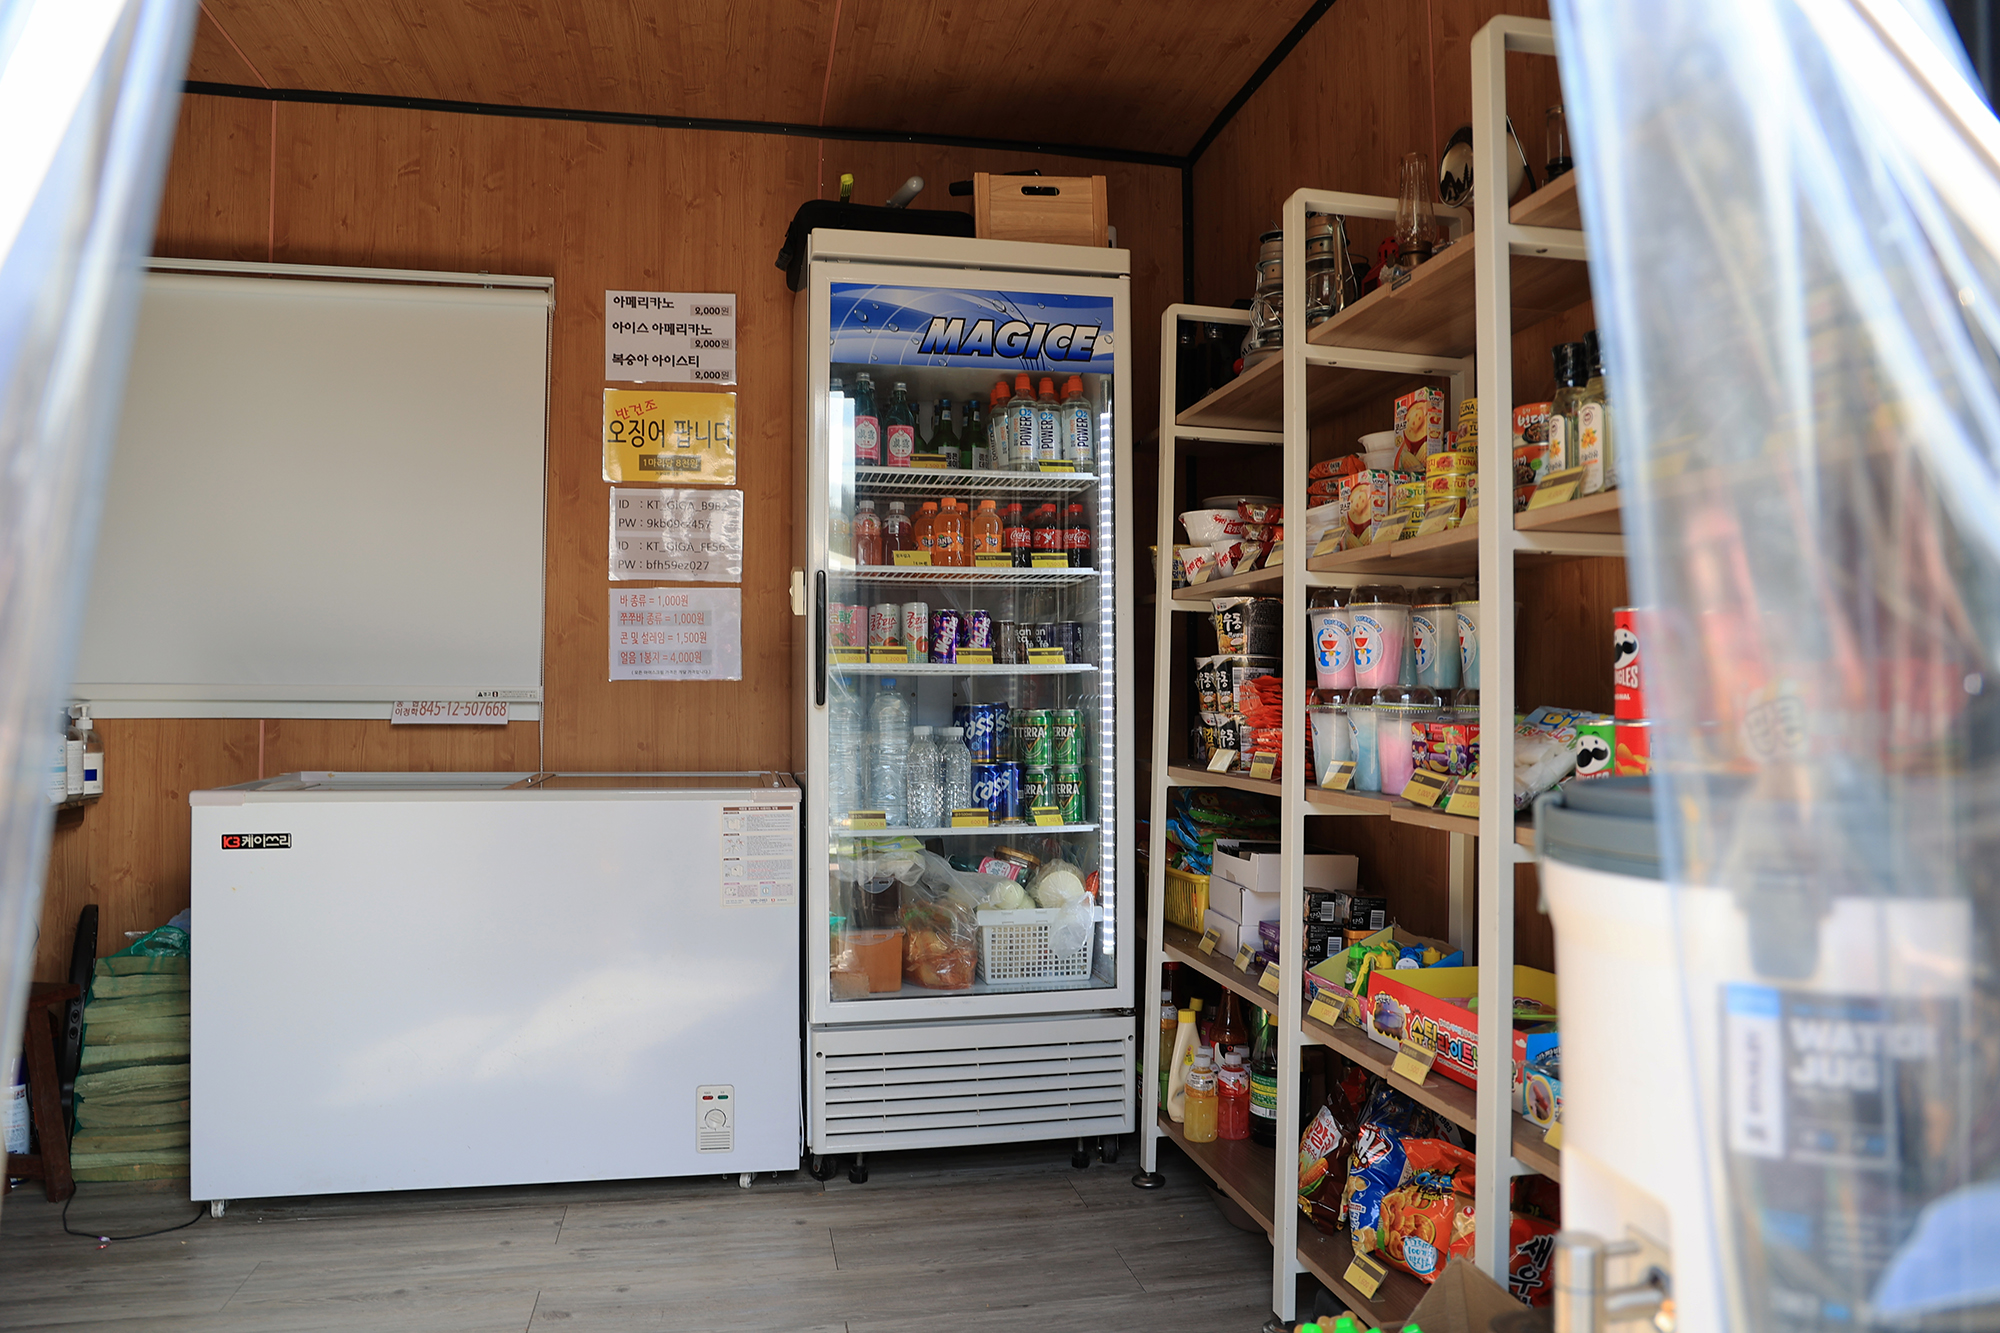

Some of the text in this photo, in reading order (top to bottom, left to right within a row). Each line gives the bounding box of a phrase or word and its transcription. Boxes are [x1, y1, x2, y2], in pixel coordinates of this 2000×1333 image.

[613, 296, 674, 309] 아메리카노
[695, 306, 729, 316] 2,000원
[612, 321, 713, 336] 아이스 아메리카노
[695, 339, 729, 349] 2,000원
[917, 316, 1101, 362] MAGICE
[612, 353, 700, 368] 복숭아 아이스티
[695, 371, 729, 380] 2,000원
[614, 399, 658, 420] 반건조
[607, 418, 665, 449] 오징어
[1019, 415, 1032, 446] POWER
[1041, 419, 1053, 449] POWER
[1077, 417, 1089, 448] POWER
[1458, 458, 1477, 467] TUNA
[1453, 480, 1466, 488] TUN
[618, 500, 630, 509] ID
[618, 518, 637, 528] PW
[618, 541, 629, 550] ID
[618, 560, 636, 569] PW
[646, 560, 710, 571] bfh59ez027
[620, 595, 628, 607] 바
[630, 594, 647, 607] 종류
[657, 594, 689, 608] 1,000원
[620, 613, 644, 625] 쭈쭈바
[646, 612, 662, 625] 종류
[673, 612, 705, 625] 1,000원
[620, 632, 628, 644] 콘
[676, 631, 707, 644] 1,500원
[620, 653, 637, 665] 얼음
[640, 652, 660, 664] 1봉지
[670, 652, 702, 664] 4,000원
[419, 701, 507, 717] 845-12-507668
[1019, 727, 1045, 739] TERRA
[1053, 727, 1074, 738] ERRA
[972, 771, 1010, 804] Cass
[241, 834, 291, 848] 케이쓰리
